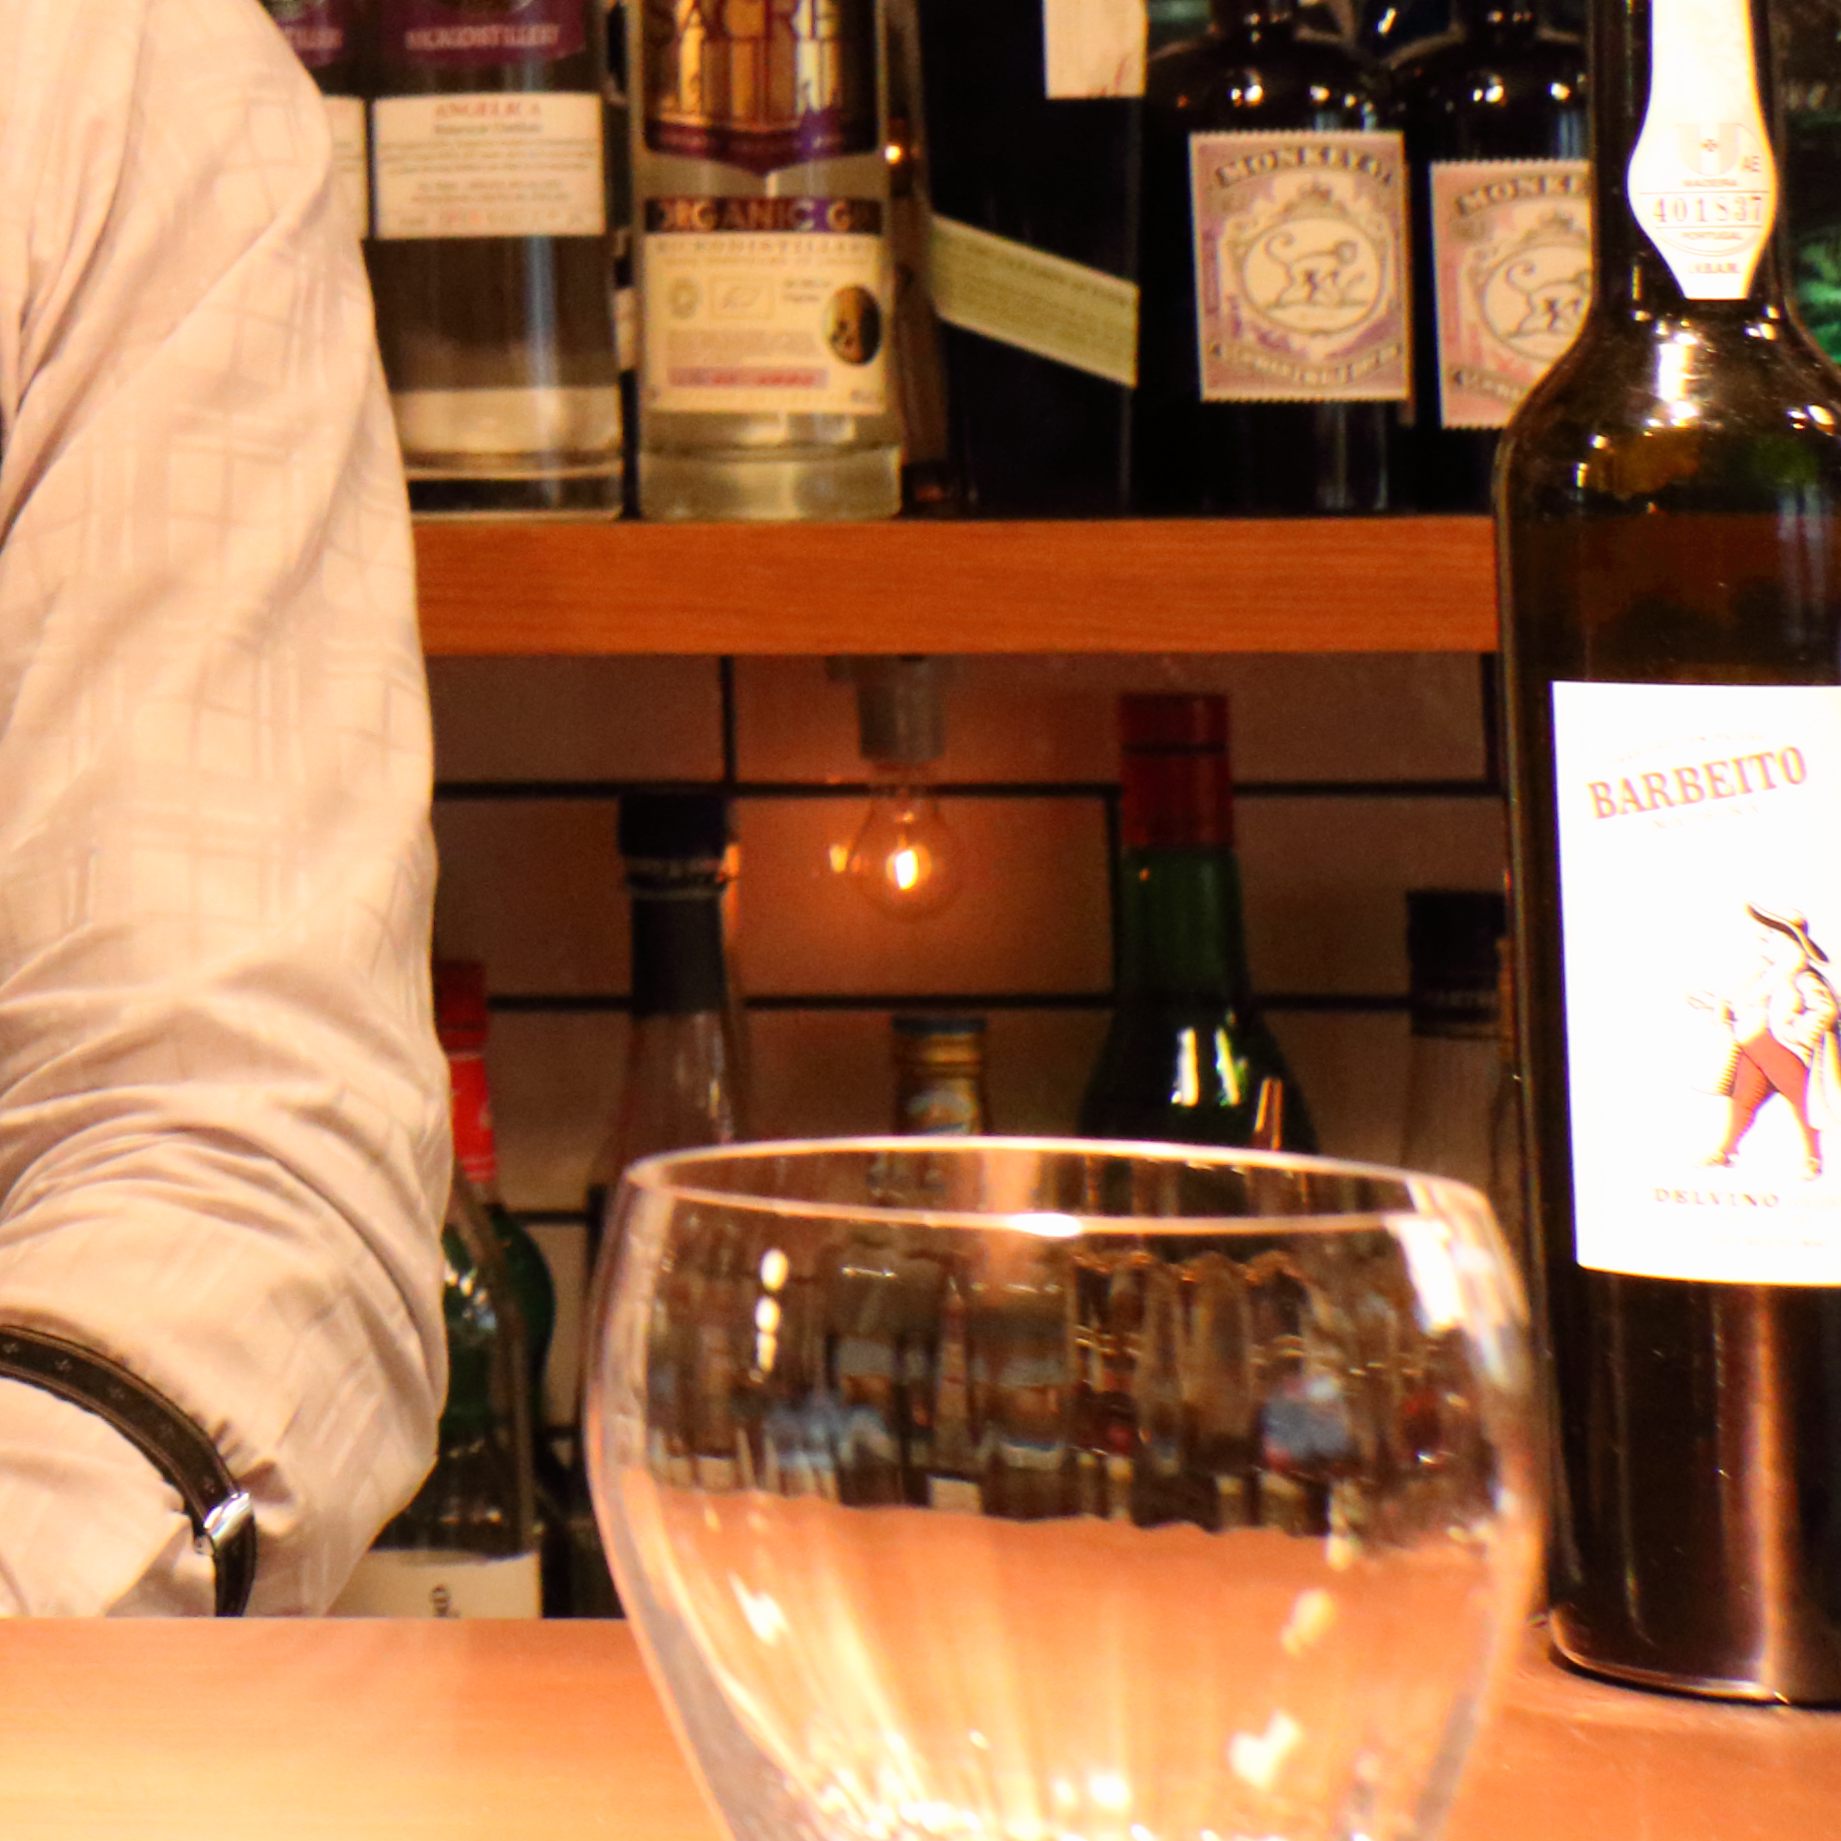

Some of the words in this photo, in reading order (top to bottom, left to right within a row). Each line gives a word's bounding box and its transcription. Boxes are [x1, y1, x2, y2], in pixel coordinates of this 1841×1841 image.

[1452, 171, 1588, 217] MONKE
[1588, 746, 1808, 821] BARBEITO
[1653, 1185, 1779, 1209] DELVINO
